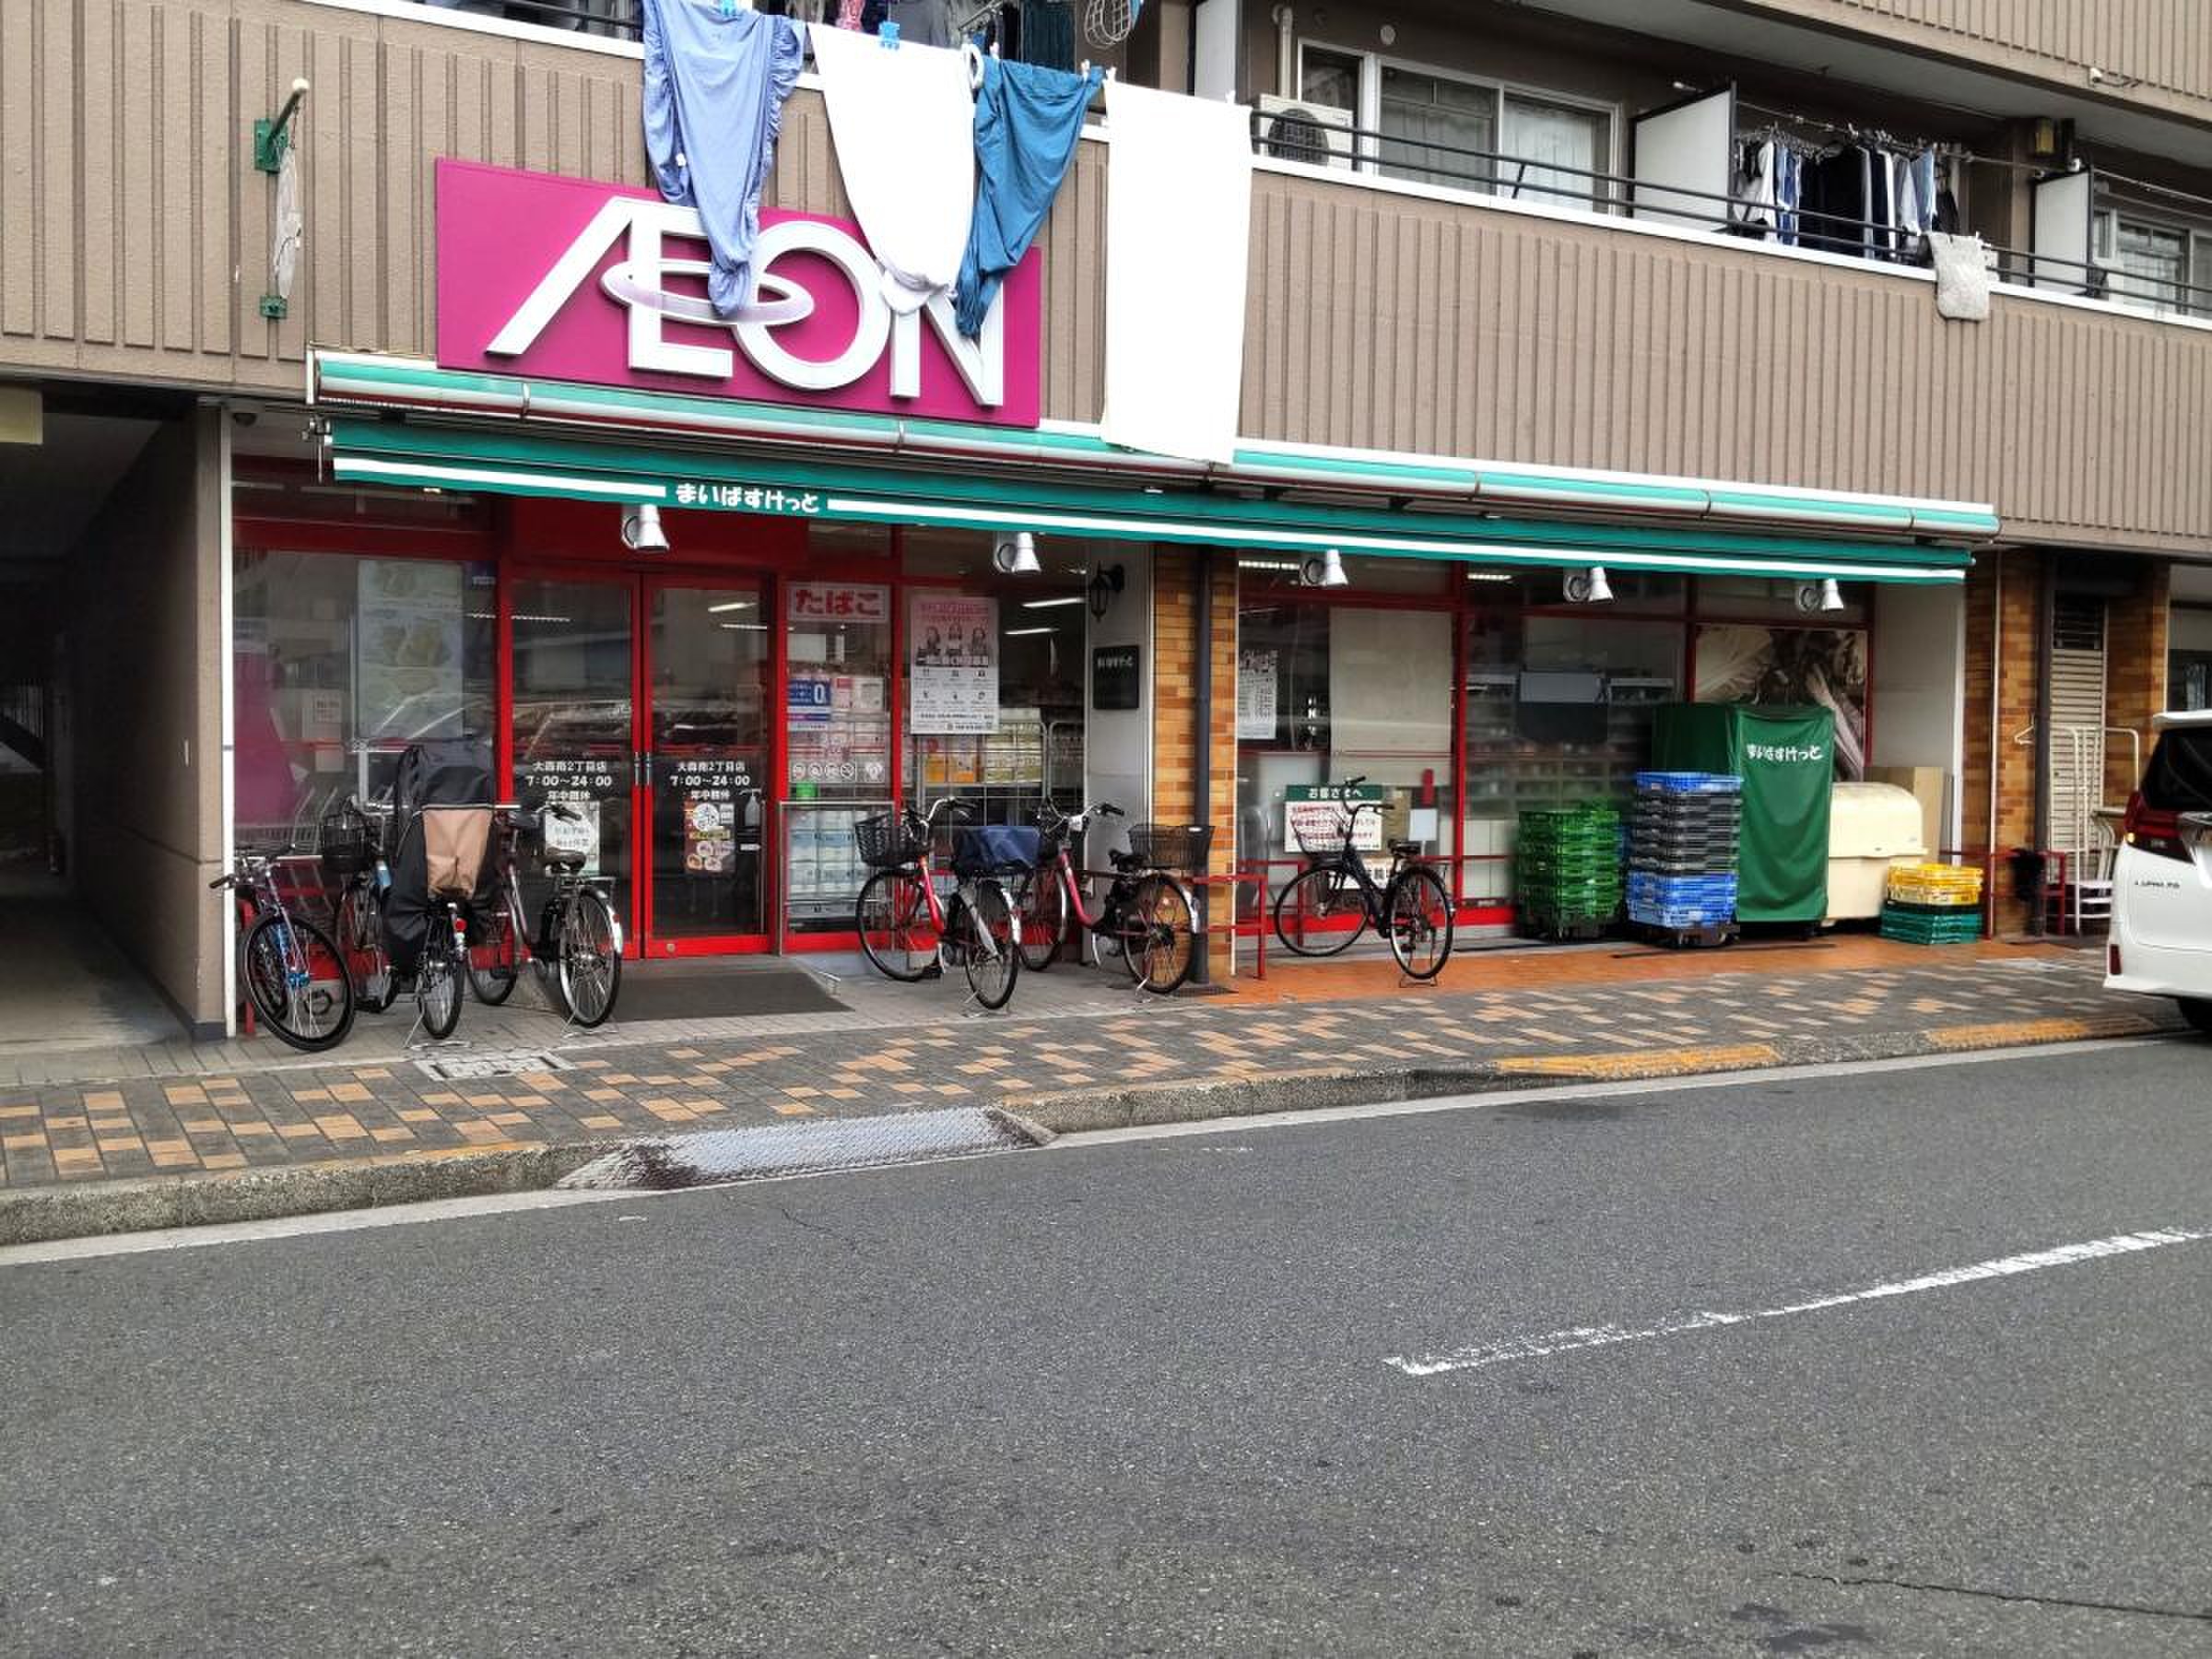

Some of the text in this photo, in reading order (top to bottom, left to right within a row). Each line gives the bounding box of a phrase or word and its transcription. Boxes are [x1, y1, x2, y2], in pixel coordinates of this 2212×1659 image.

[676, 483, 819, 513] まいばすけっと
[794, 589, 881, 616] たばこ
[1747, 744, 1823, 762] まいばすけっと
